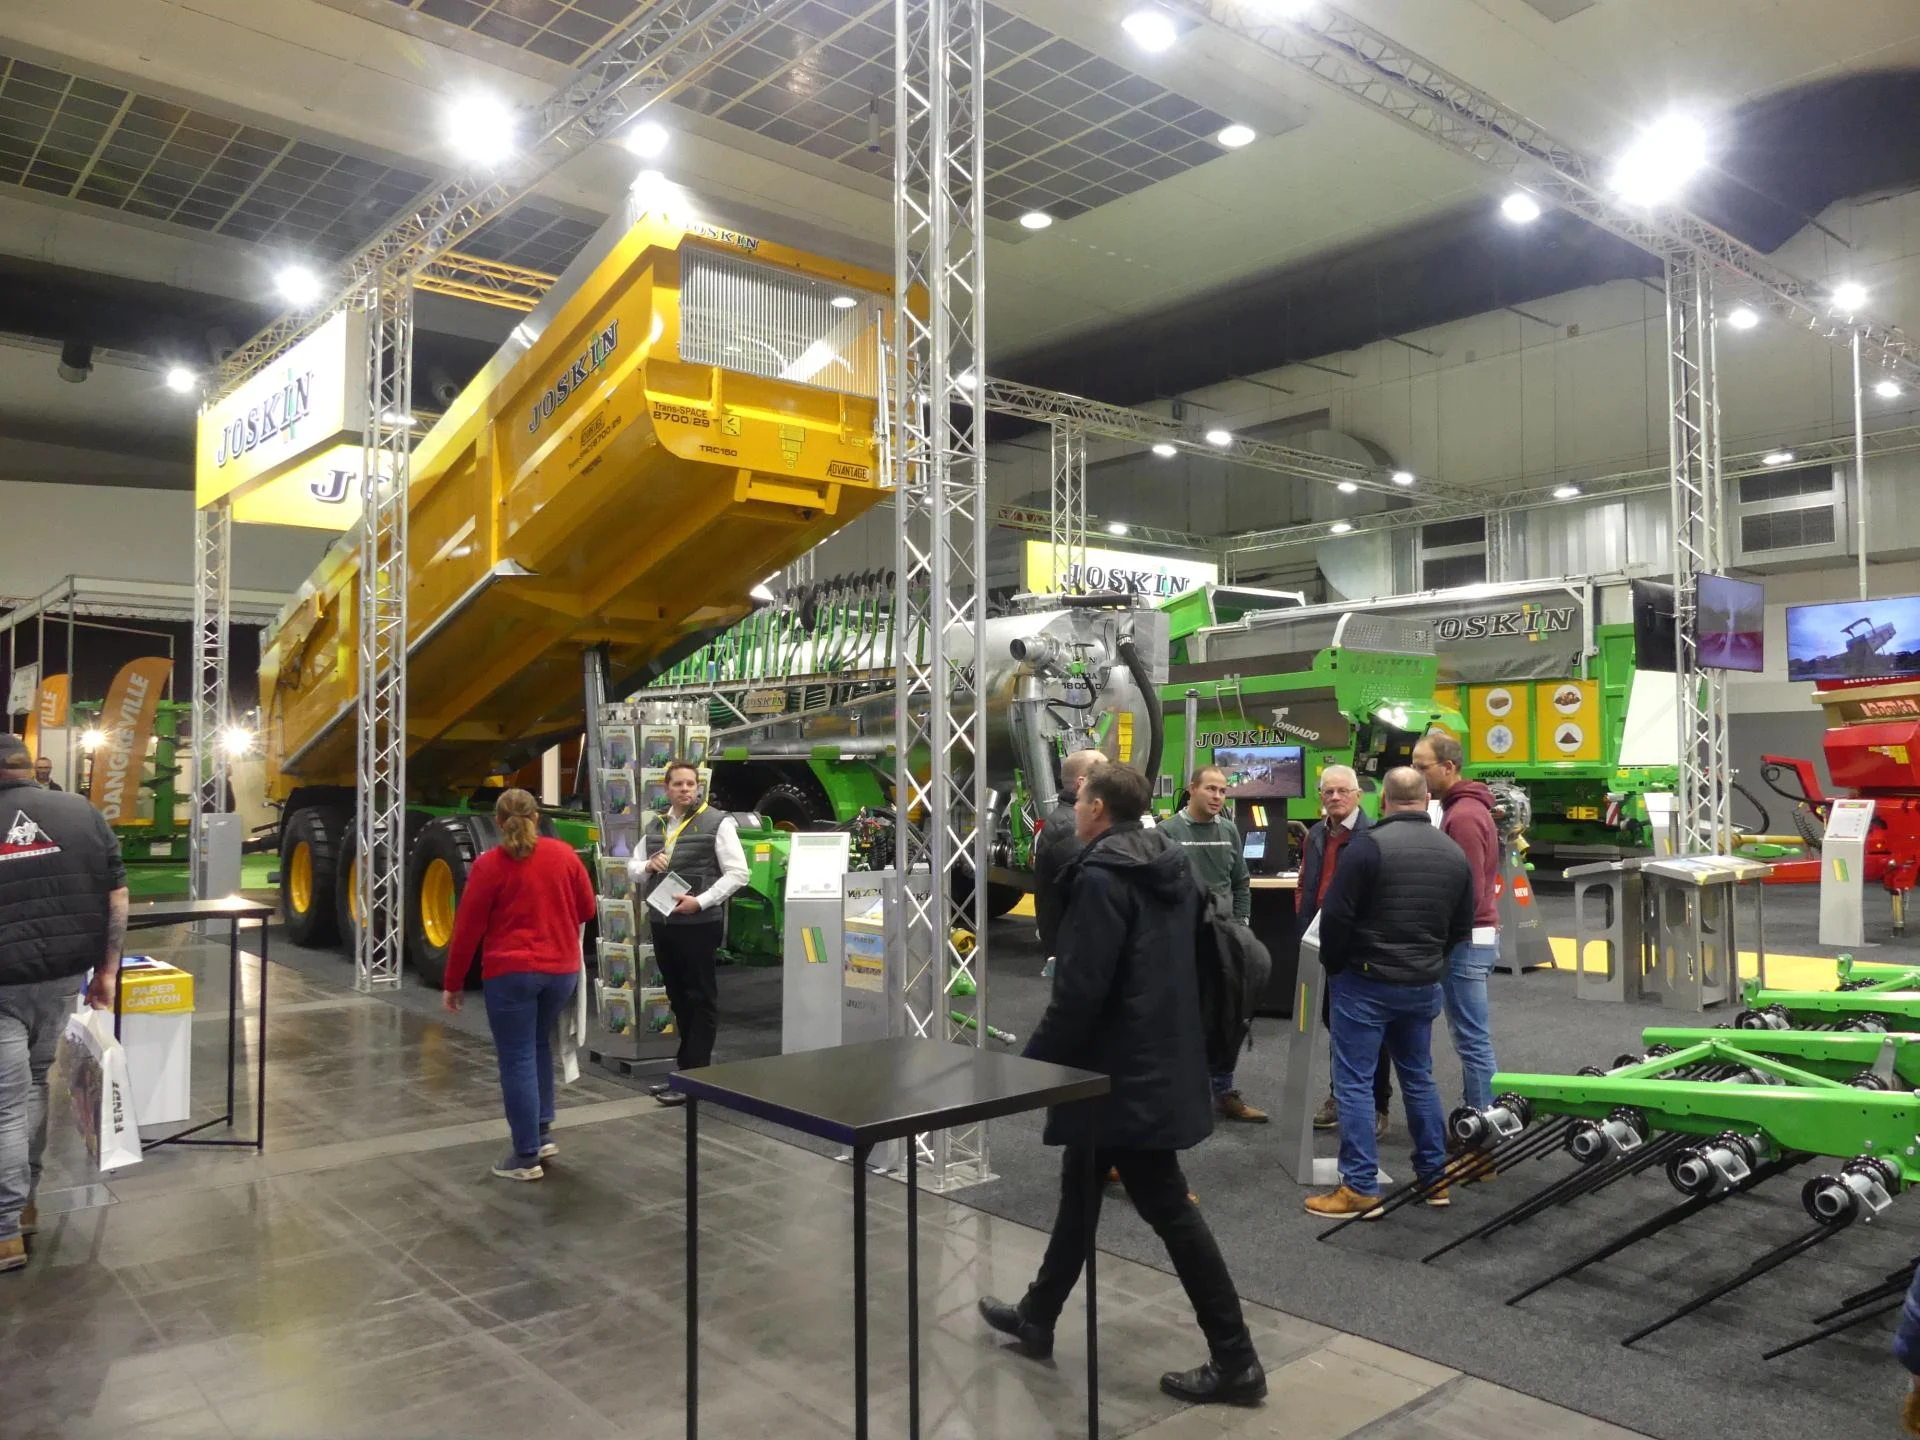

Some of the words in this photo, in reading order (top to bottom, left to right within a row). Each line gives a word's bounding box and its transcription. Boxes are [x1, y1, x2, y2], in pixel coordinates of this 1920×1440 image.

[528, 318, 619, 433] JOSKIN
[217, 368, 314, 468] JOSKIN
[654, 402, 708, 418] Trans-SPACE
[653, 411, 710, 428] 8700/29
[826, 463, 868, 480] ADVANTAGE
[1053, 564, 1190, 598] JOSKIN
[1432, 607, 1575, 641] OSKIN
[1272, 707, 1320, 741] TORNADO
[1196, 729, 1288, 749] JOSKIN
[1514, 887, 1529, 897] NEW
[132, 983, 176, 996] PAPER
[126, 993, 182, 1008] CARTON
